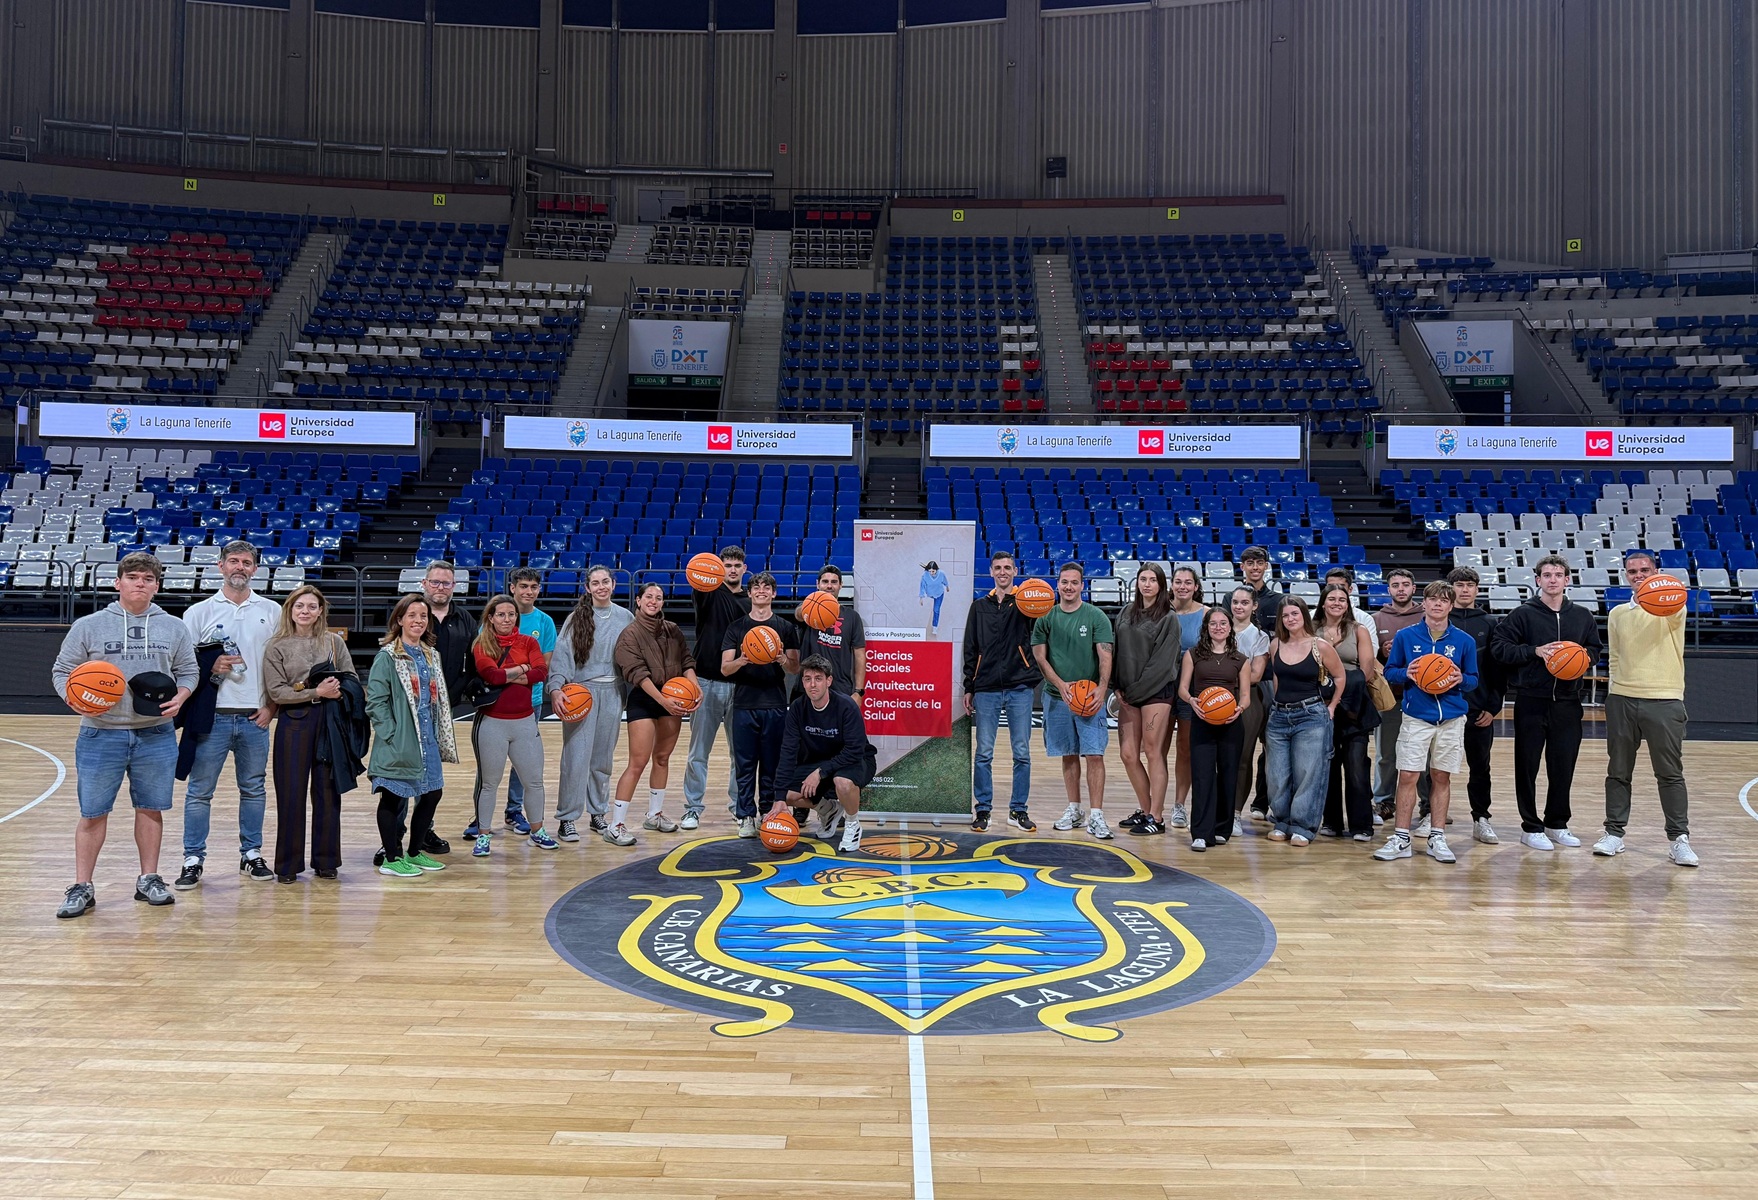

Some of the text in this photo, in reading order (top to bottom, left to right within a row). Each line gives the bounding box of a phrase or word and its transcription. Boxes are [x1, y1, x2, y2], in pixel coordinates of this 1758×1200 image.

[436, 195, 443, 204] Ñ
[1570, 241, 1579, 250] Q
[673, 329, 683, 339] 25
[1457, 330, 1468, 340] 25
[672, 350, 708, 362] DXT
[1454, 350, 1494, 364] DXT
[140, 416, 232, 429] La Laguna Tenerife
[262, 420, 282, 431] ue
[290, 417, 354, 427] Universidad
[290, 427, 334, 438] Europea
[597, 429, 682, 442] La Laguna Tenerife
[711, 433, 729, 443] ue
[737, 430, 796, 439] Universidad
[1169, 433, 1231, 441] Universidad
[737, 439, 778, 449] Europea
[1027, 436, 1112, 448] La Laguna Tenerife
[1142, 437, 1160, 448] ue
[1467, 437, 1557, 449] La Laguna Tenerife
[1589, 438, 1609, 449] ue
[1618, 434, 1685, 443] Universidad
[1169, 443, 1211, 453] Europea
[1618, 445, 1664, 455] Europea
[692, 572, 718, 584] Wilson
[1649, 579, 1682, 589] Wilson
[1024, 590, 1050, 598] Wilson
[760, 629, 775, 652] Wilson
[865, 650, 913, 660] Ciencias
[865, 663, 910, 673] Sociales
[99, 680, 115, 688] acb
[864, 680, 934, 691] Arquitectura
[1437, 675, 1454, 687] Wil
[81, 690, 116, 706] Wilson
[864, 698, 942, 709] Ciencias de la
[1207, 693, 1231, 707] Wilson
[864, 711, 895, 720] Salud
[766, 822, 792, 833] Wilson
[821, 875, 988, 899] C.B.C.
[654, 909, 793, 997] C.B. CANARIAS
[1002, 910, 1172, 1008] LA LAGUNA TFE
